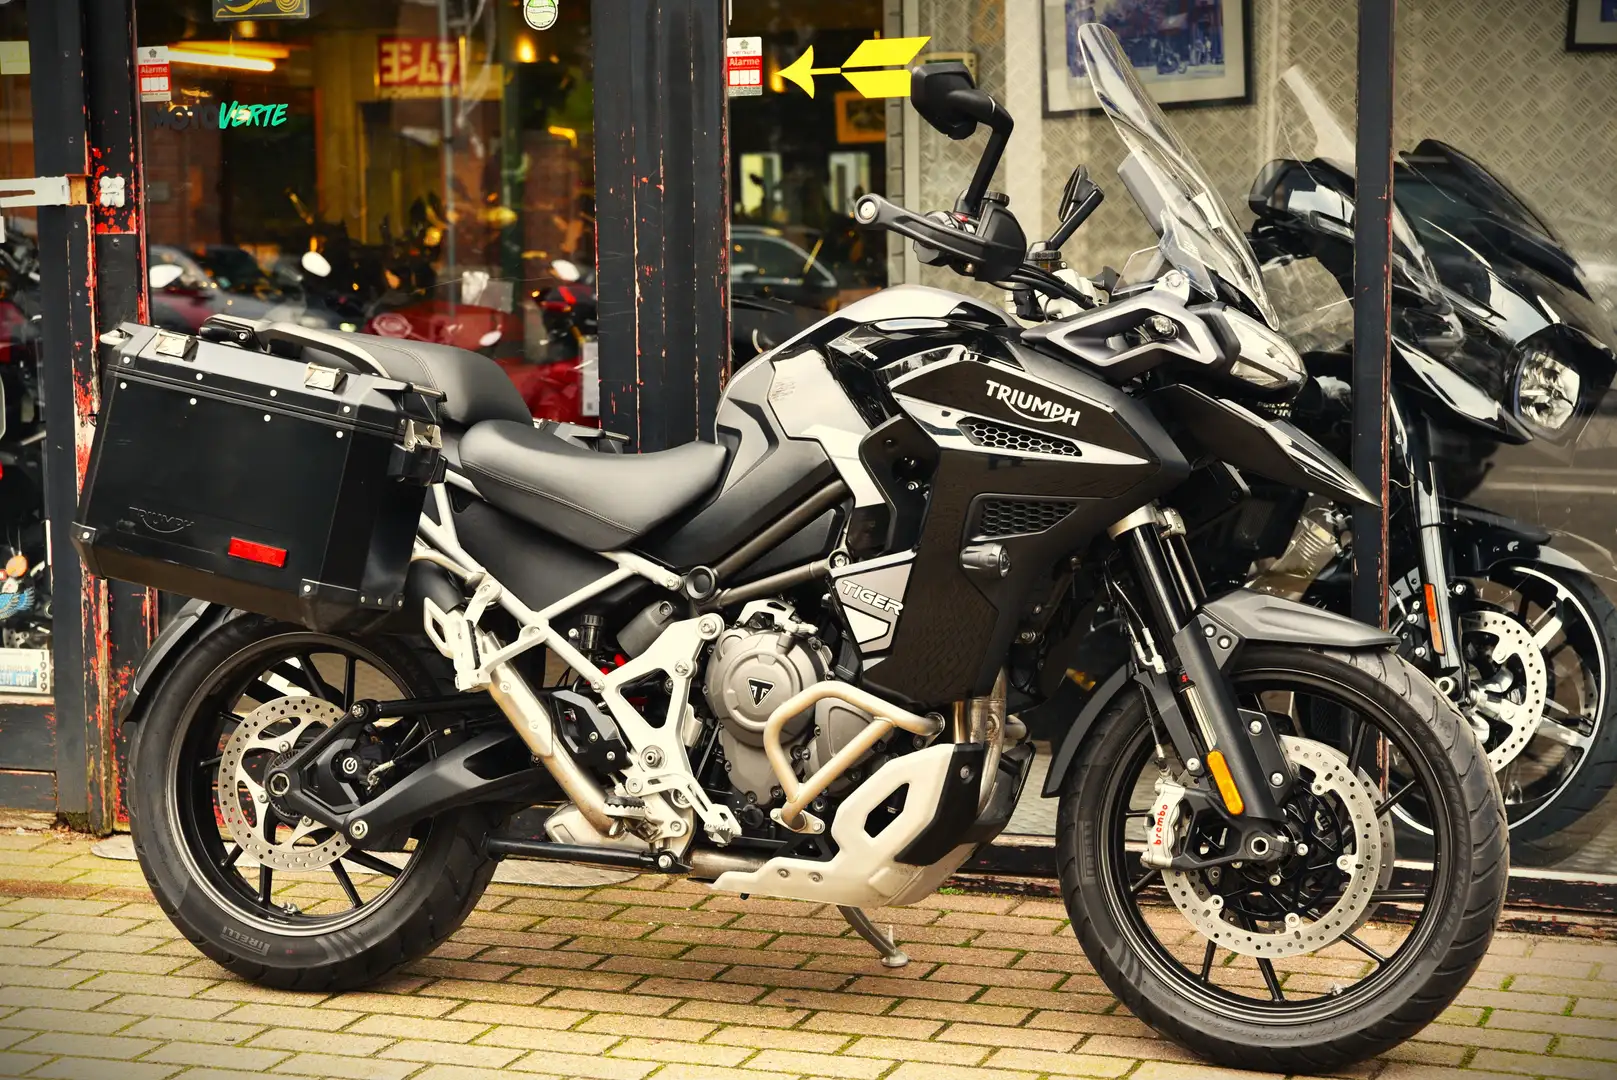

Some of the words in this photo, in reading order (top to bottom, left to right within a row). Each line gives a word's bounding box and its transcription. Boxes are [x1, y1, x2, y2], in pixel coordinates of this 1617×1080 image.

[141, 65, 168, 74] Alarme
[729, 57, 760, 66] Alarme
[218, 100, 288, 129] VERTE
[986, 379, 1081, 426] TRIUMPH
[842, 580, 904, 616] TIGER
[39, 651, 48, 692] 1999
[1152, 804, 1169, 846] brembo
[221, 925, 271, 957] PIRELLI
